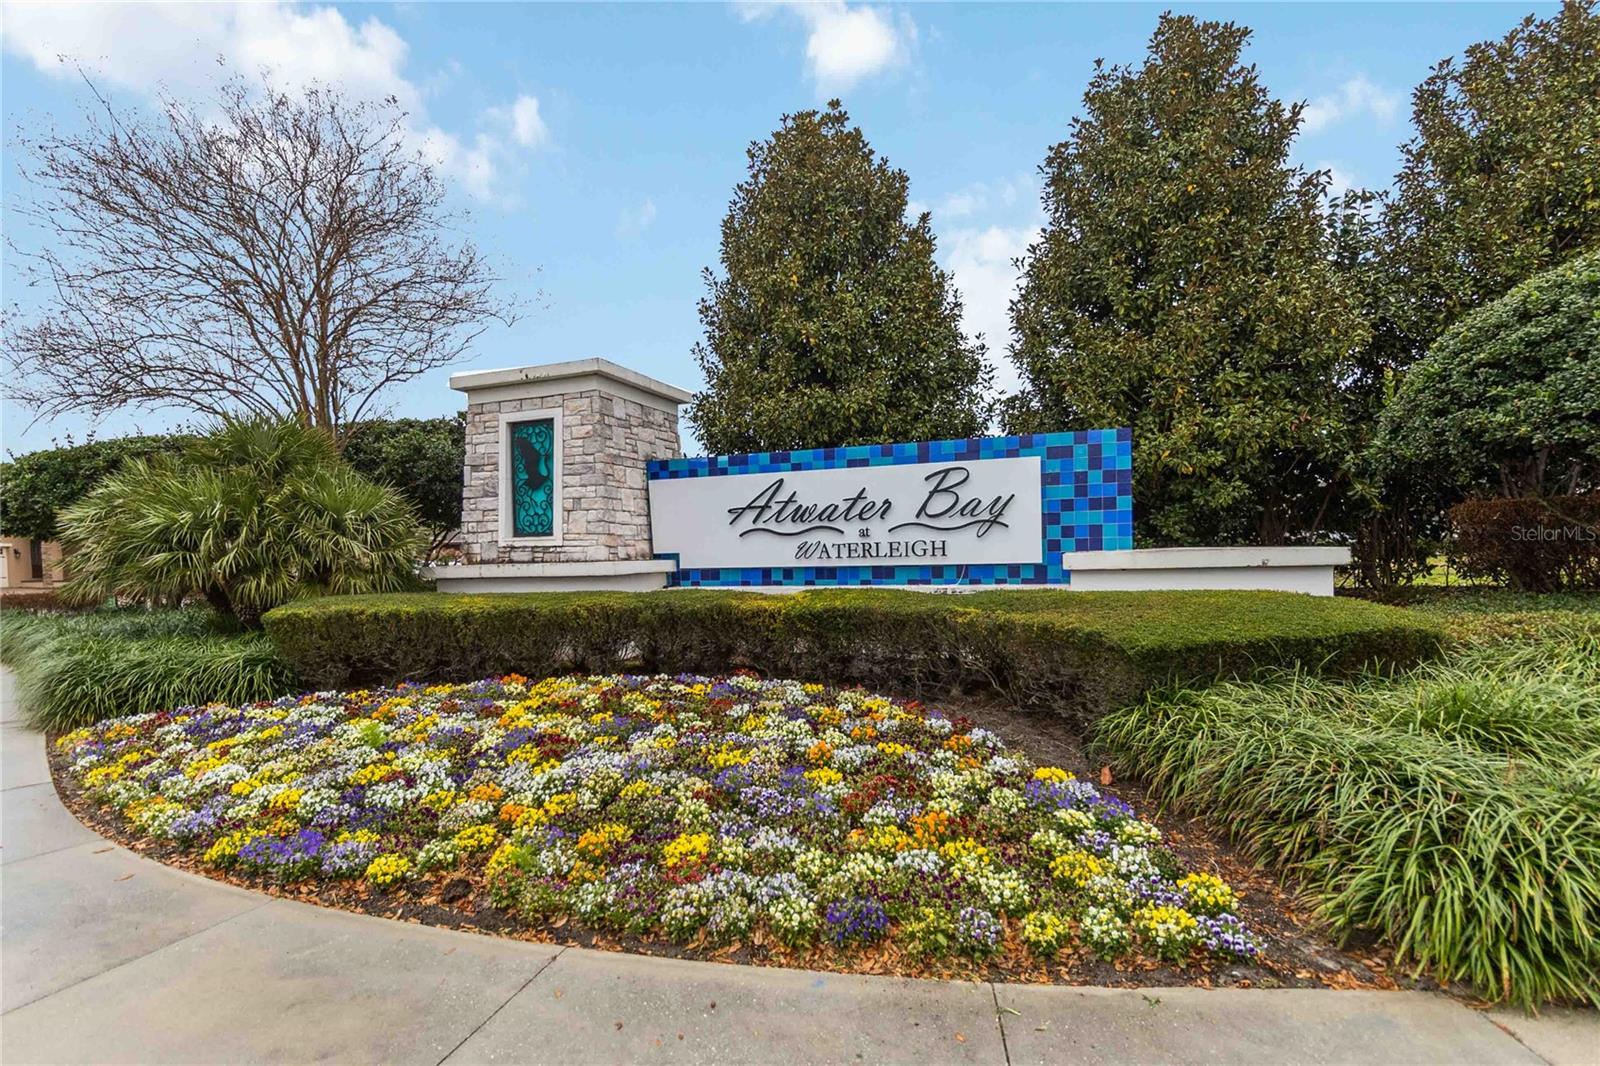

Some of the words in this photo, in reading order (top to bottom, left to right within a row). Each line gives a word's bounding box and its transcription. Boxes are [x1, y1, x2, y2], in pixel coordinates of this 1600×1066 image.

[728, 477, 892, 525] Atwater
[915, 466, 1016, 538] Bay
[858, 526, 871, 538] at
[795, 540, 948, 560] WATERLEIGH
